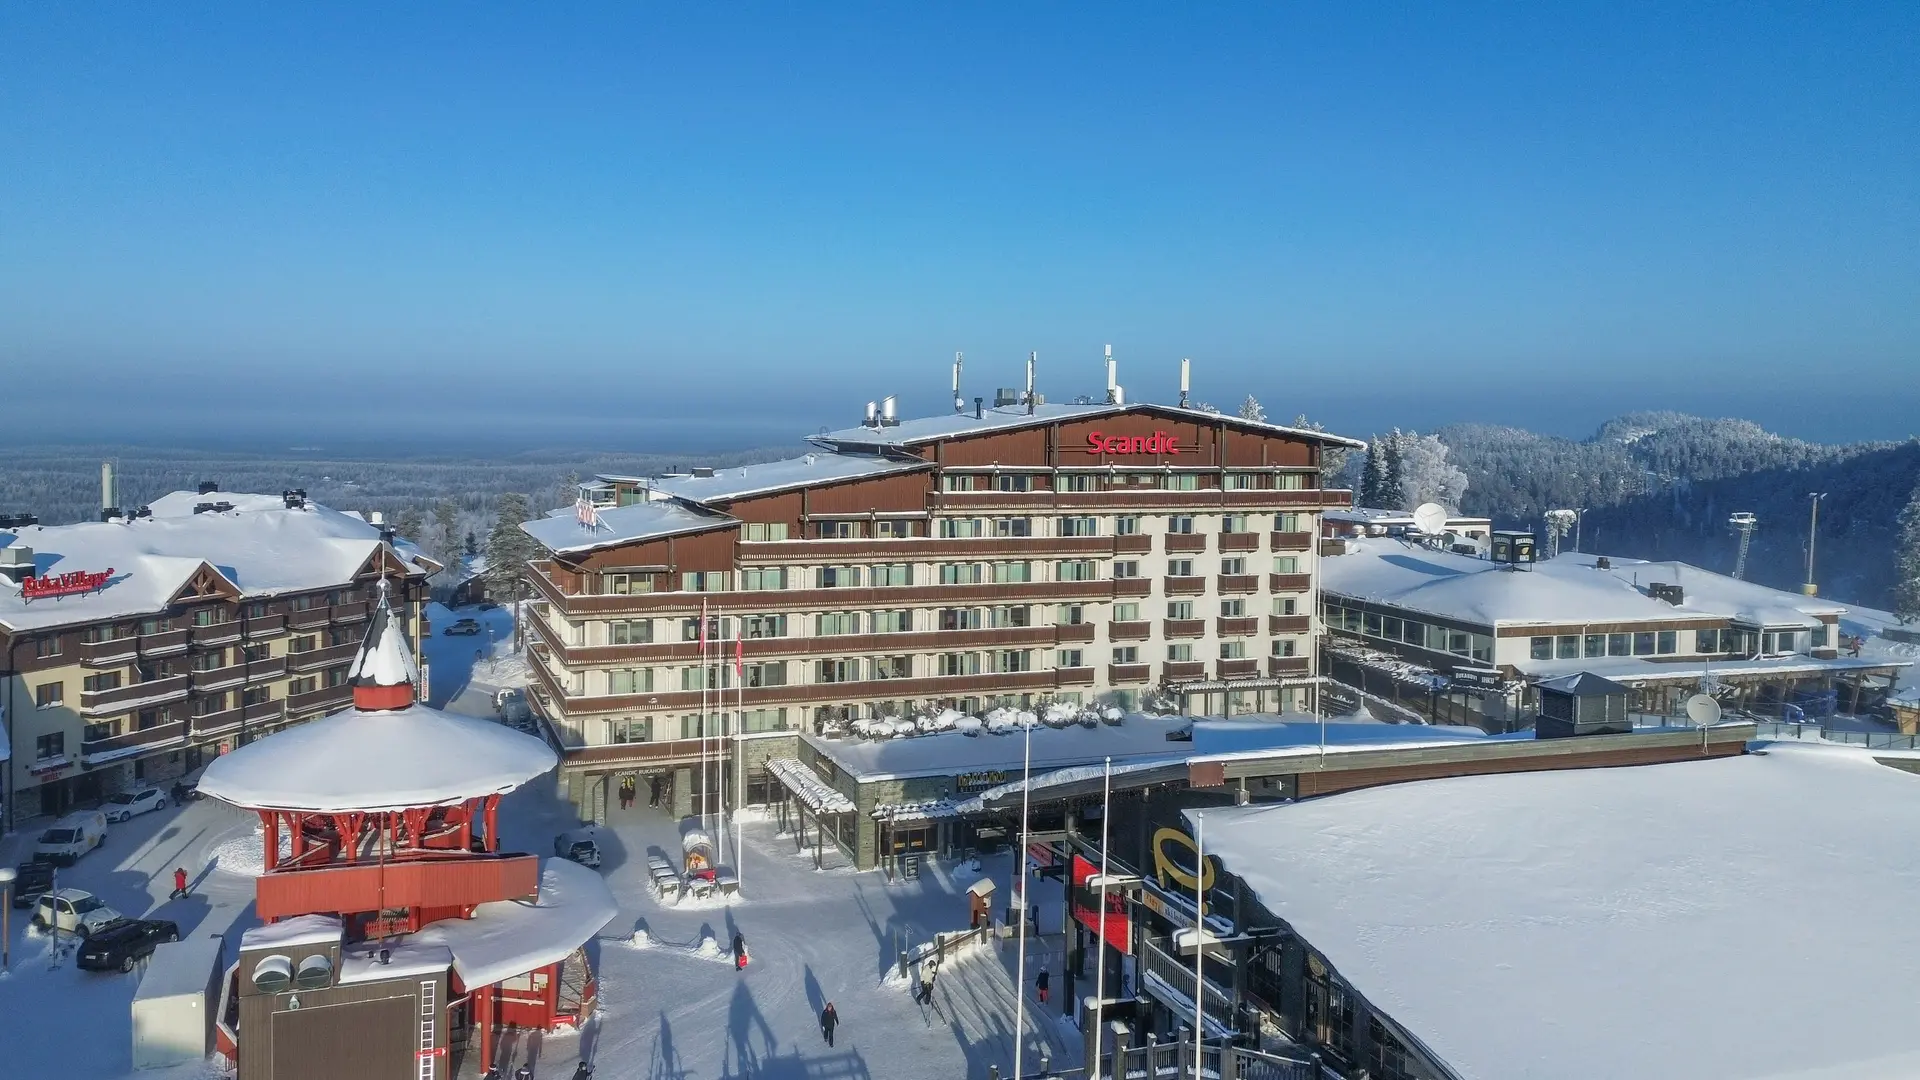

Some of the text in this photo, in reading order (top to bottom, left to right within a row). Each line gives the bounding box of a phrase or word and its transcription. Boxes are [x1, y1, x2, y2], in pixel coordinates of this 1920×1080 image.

[1088, 430, 1179, 454] Scandic
[23, 571, 107, 591] Ruka Village
